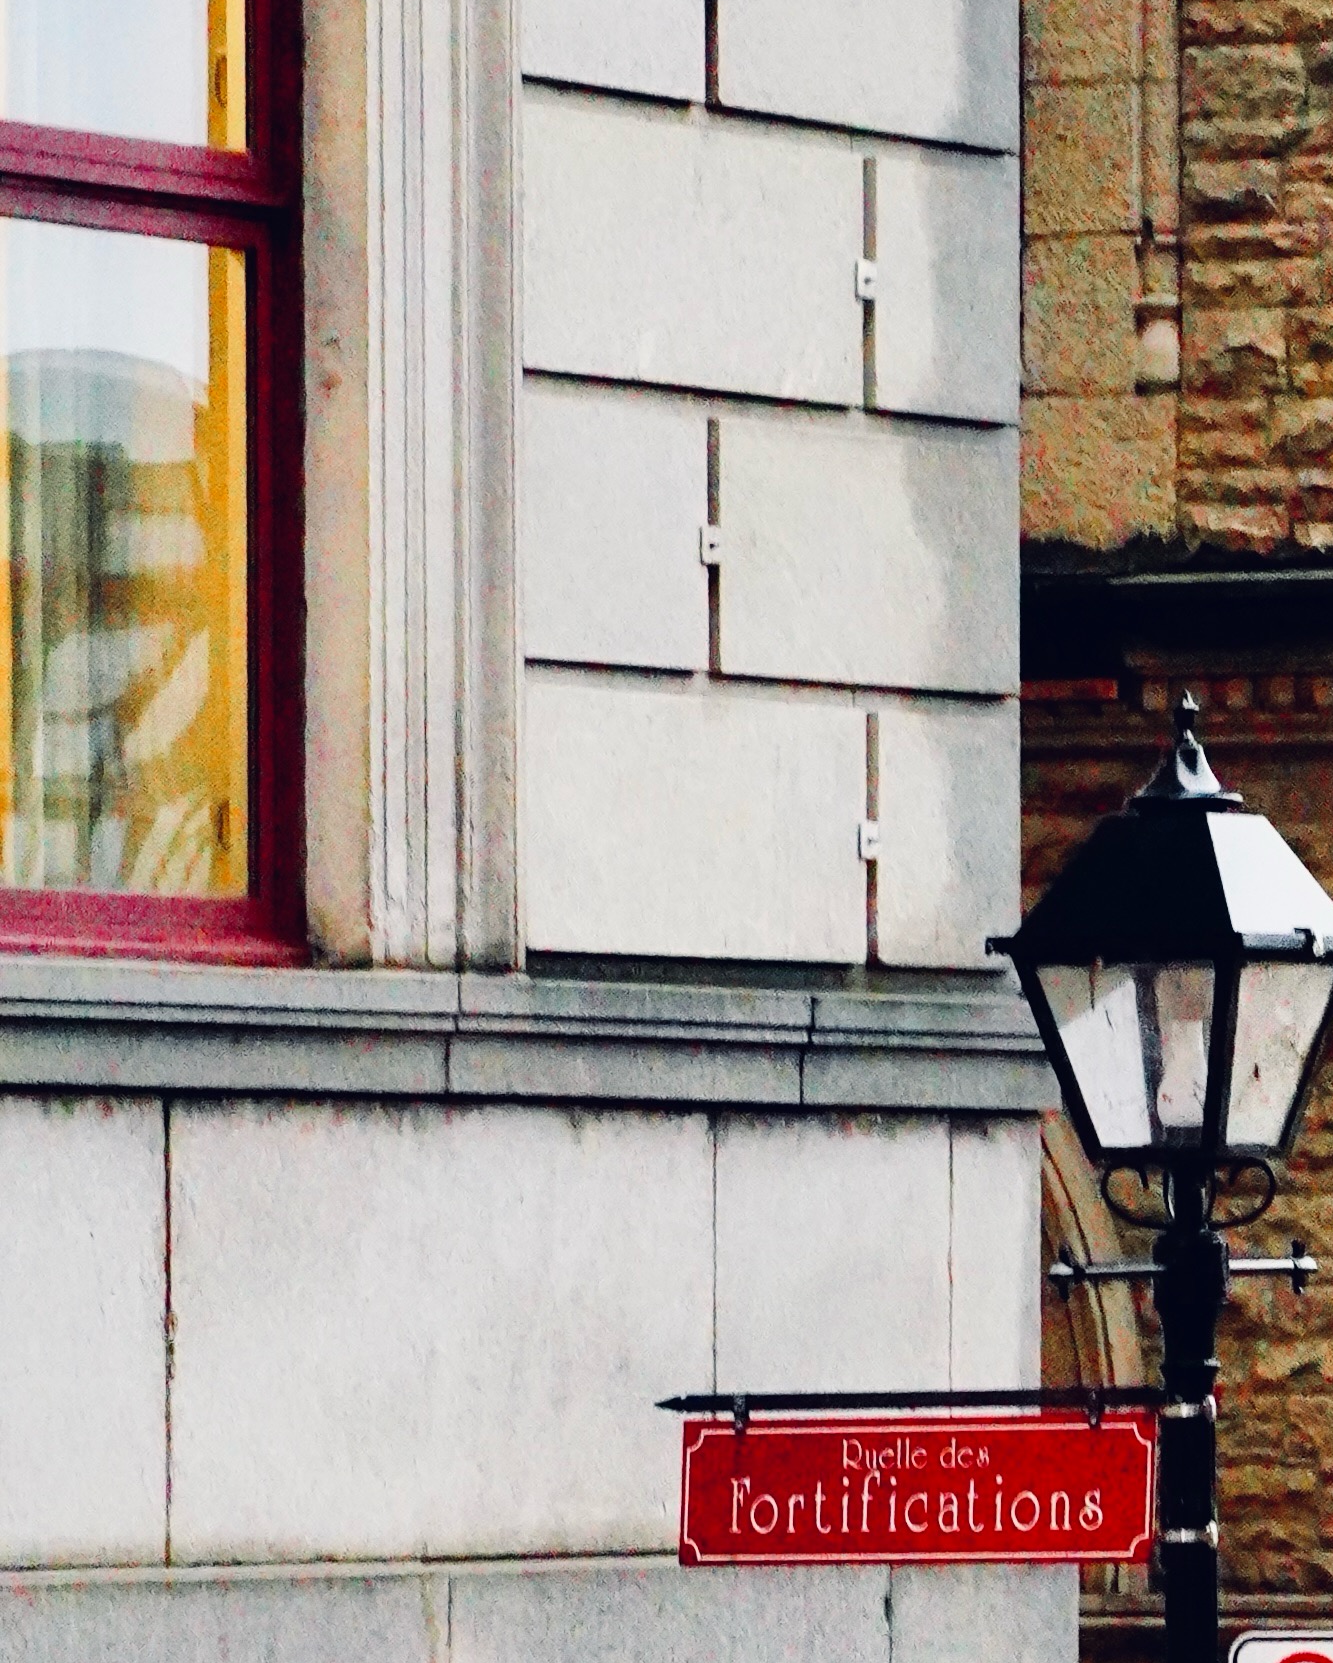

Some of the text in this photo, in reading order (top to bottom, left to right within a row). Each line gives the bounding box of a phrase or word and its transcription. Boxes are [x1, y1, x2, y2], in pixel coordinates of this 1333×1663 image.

[842, 1437, 990, 1473] Ruelle des
[728, 1469, 1104, 1534] Fortifications
